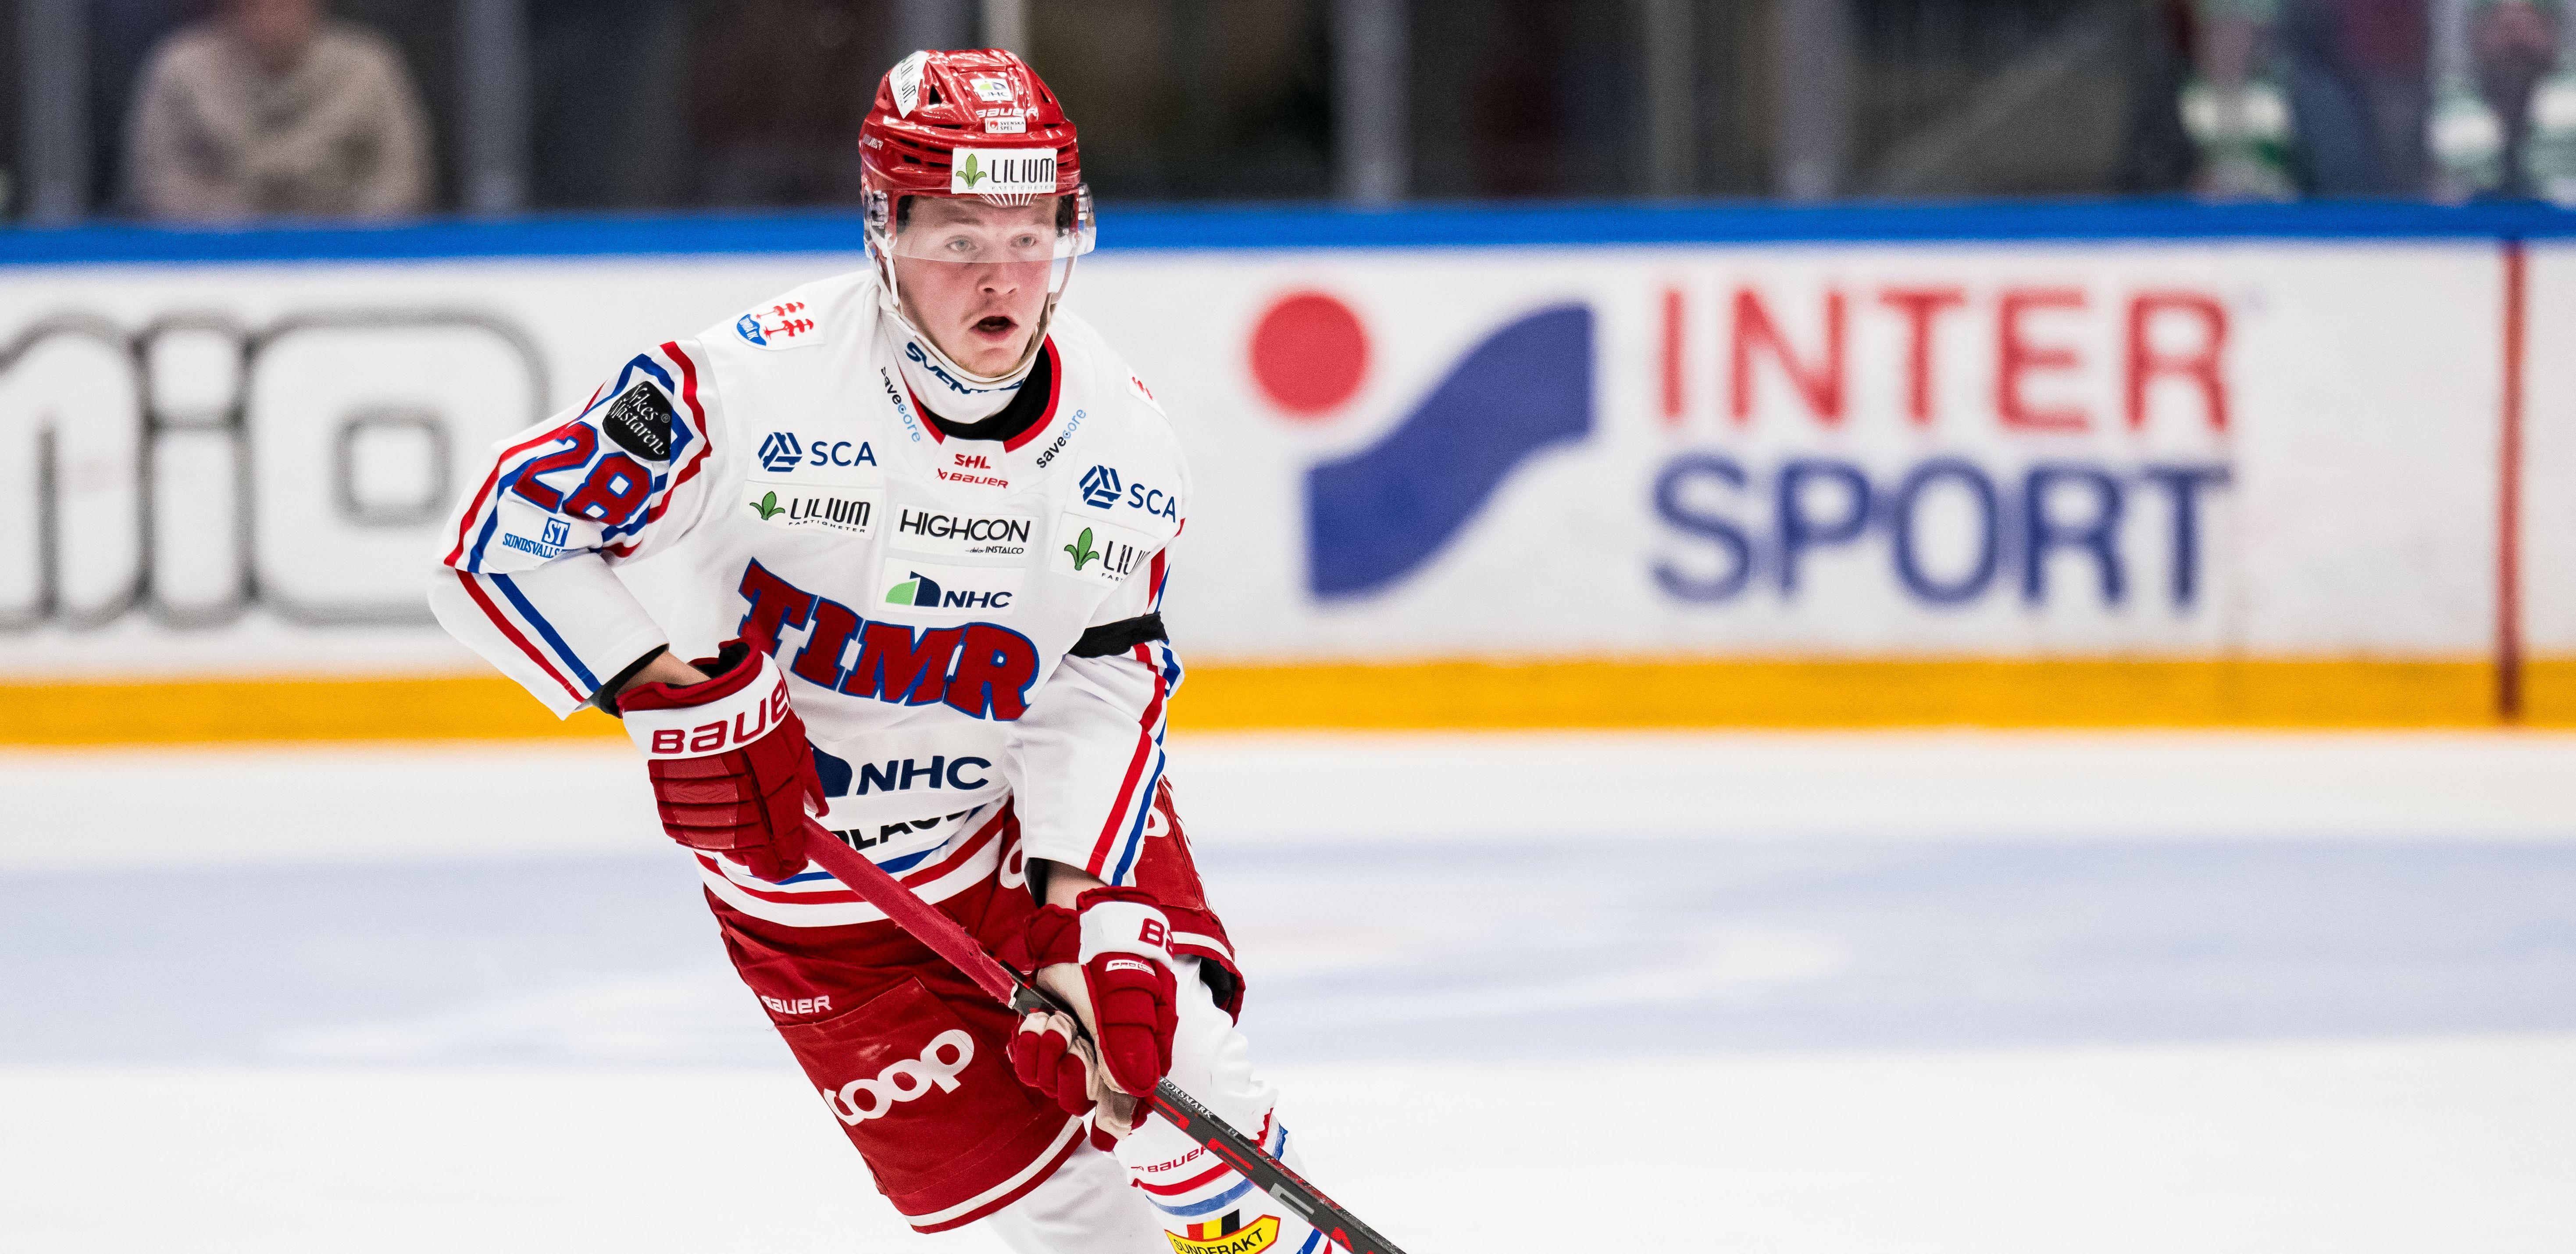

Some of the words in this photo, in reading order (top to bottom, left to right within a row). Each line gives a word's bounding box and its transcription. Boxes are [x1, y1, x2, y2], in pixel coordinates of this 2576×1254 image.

[991, 157, 1054, 183] LILIUM
[1660, 287, 2229, 430] INTER
[810, 440, 877, 467] SCA
[1036, 409, 1086, 468] savecore
[511, 421, 654, 525] 28
[954, 454, 991, 470] SHL
[790, 497, 871, 526] LILIUM
[1127, 483, 1176, 524] SCA
[544, 520, 569, 545] ST
[788, 519, 866, 533] FASTIGHETER
[899, 508, 1031, 543] HIGHCON
[1651, 454, 2231, 607] SPORT
[503, 532, 560, 559] SUNDSVALLS
[985, 546, 1024, 554] INSTALCO
[943, 590, 1013, 609] NHC
[738, 557, 1040, 722] TIMR
[857, 755, 992, 796] NHC
[824, 1029, 974, 1127] coop
[1159, 1077, 1213, 1119] FORSMARK
